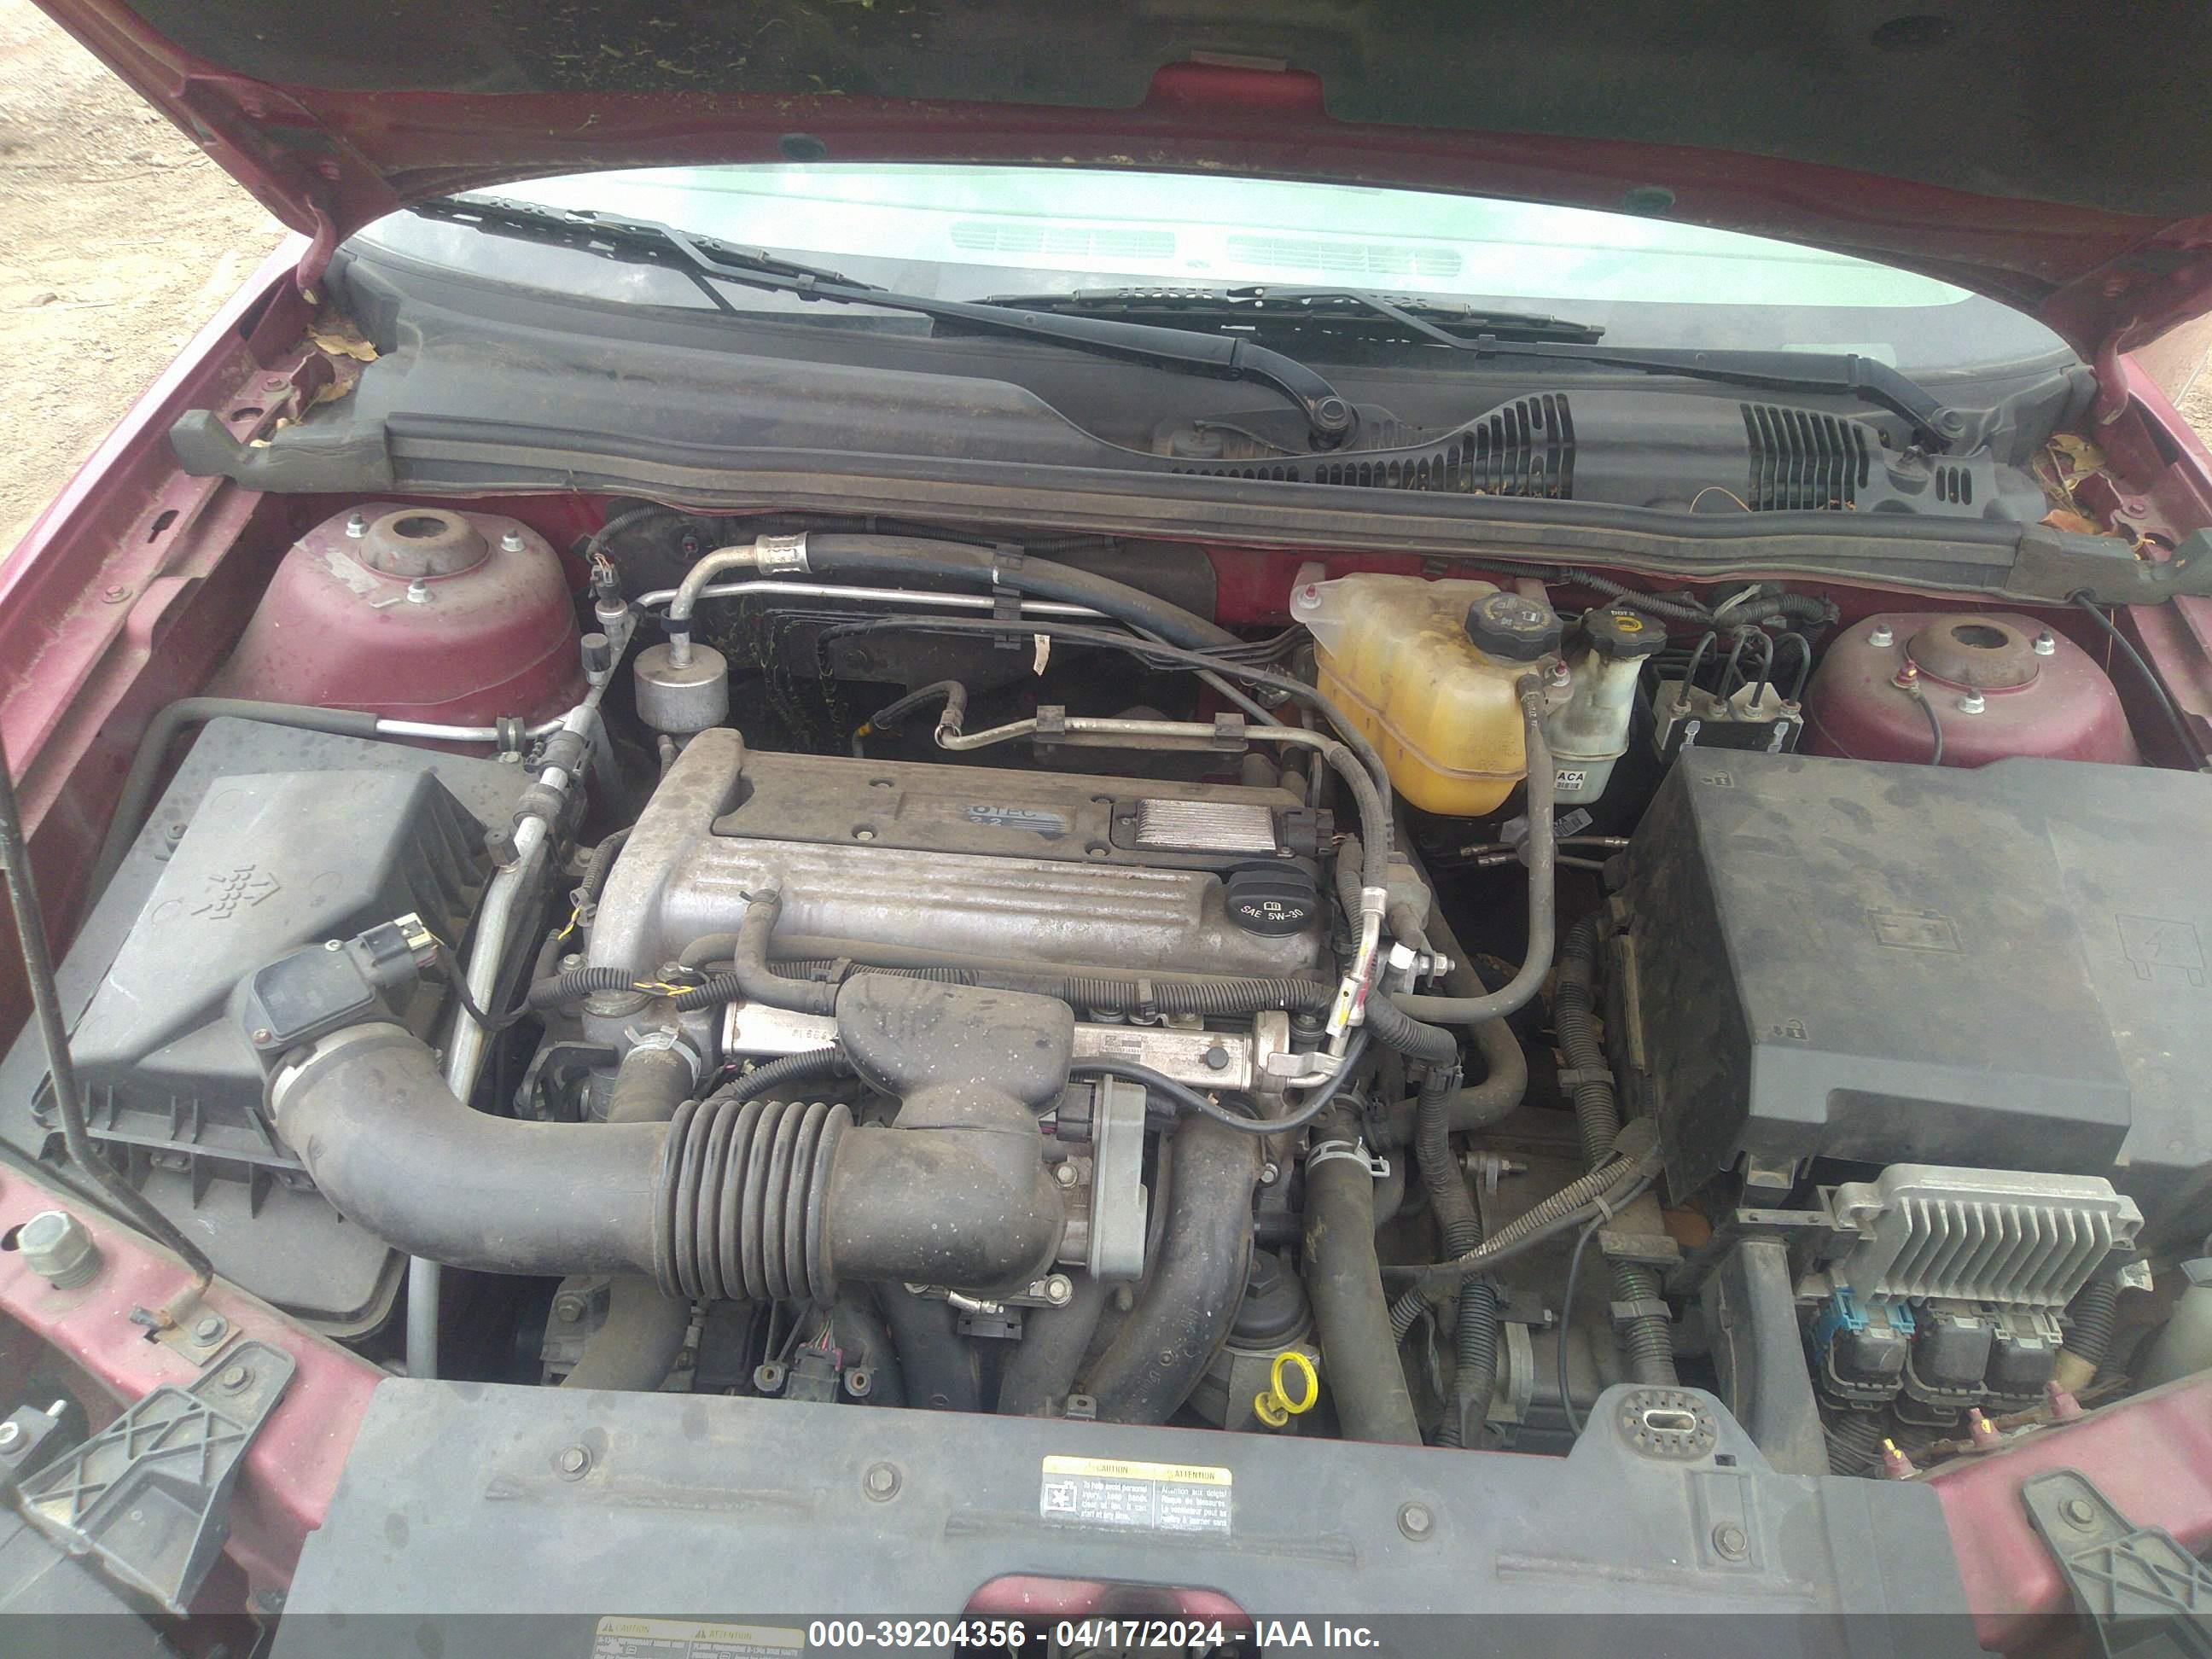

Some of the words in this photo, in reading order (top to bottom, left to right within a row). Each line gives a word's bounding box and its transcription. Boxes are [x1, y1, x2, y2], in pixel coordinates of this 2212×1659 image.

[1557, 771, 1584, 781] ACA
[1240, 905, 1262, 918] SAE
[1268, 909, 1304, 921] 5W-30
[1096, 1464, 1128, 1475] CAUTION
[1174, 1470, 1215, 1481] ATTENTION
[614, 1624, 650, 1633] CAUTION
[708, 1630, 753, 1640] ATTENTION
